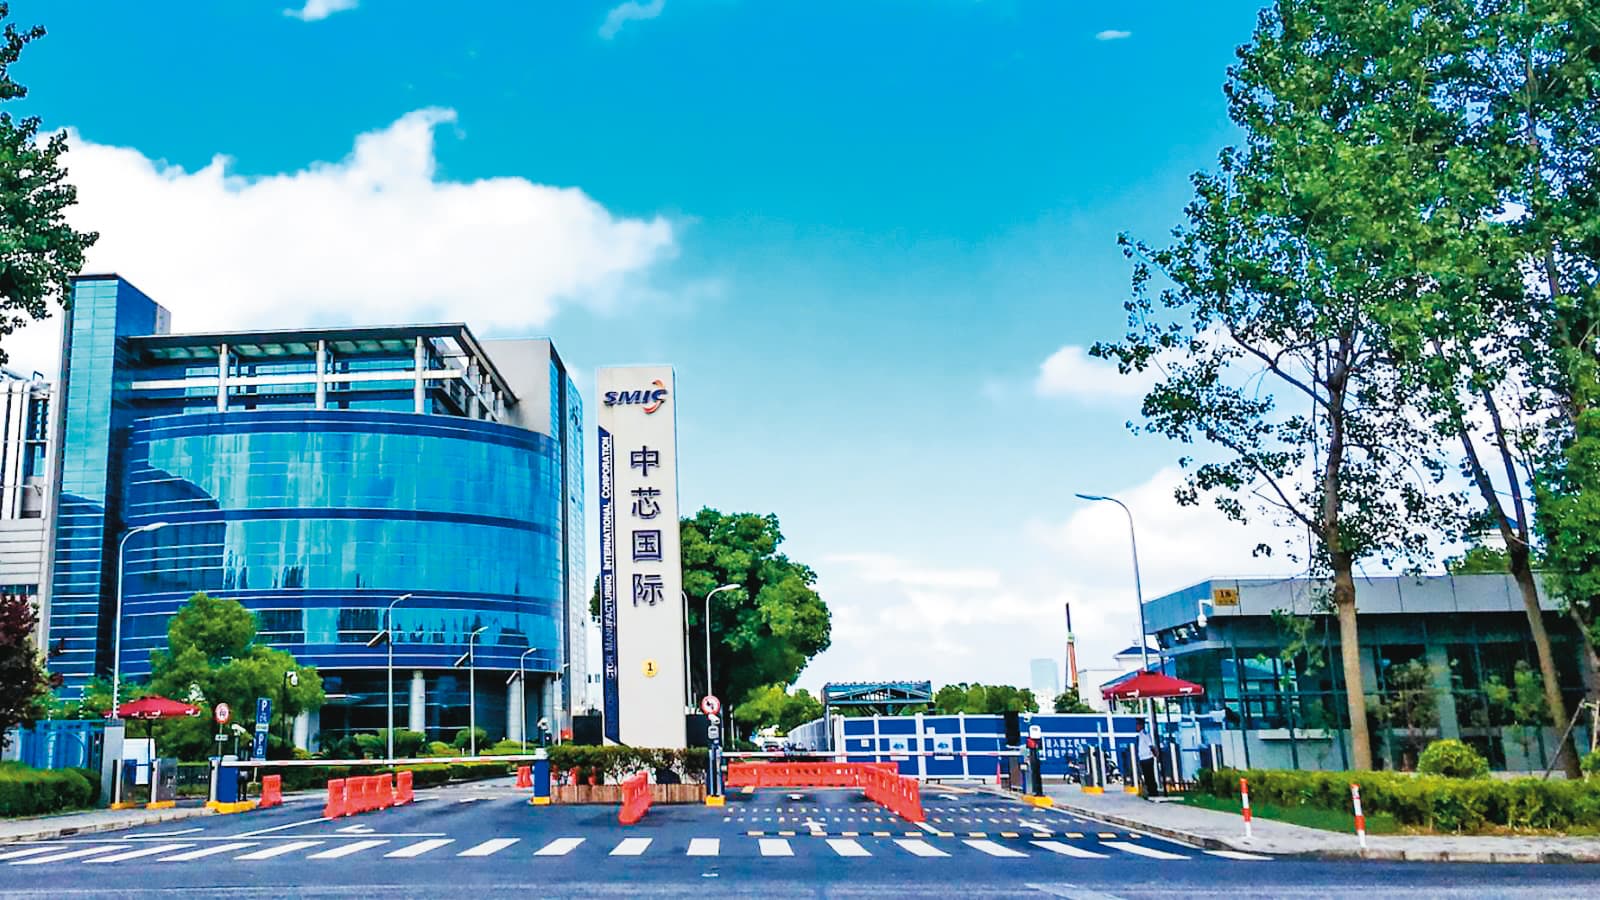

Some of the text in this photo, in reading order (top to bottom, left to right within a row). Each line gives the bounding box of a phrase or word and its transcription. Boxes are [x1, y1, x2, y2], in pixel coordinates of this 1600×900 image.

[603, 388, 668, 406] SMIC
[601, 436, 611, 499] CORPORATION
[602, 503, 613, 570] INTERNATIONAL
[630, 445, 663, 607] 中芯国际
[647, 662, 653, 671] 1
[261, 700, 268, 711] P
